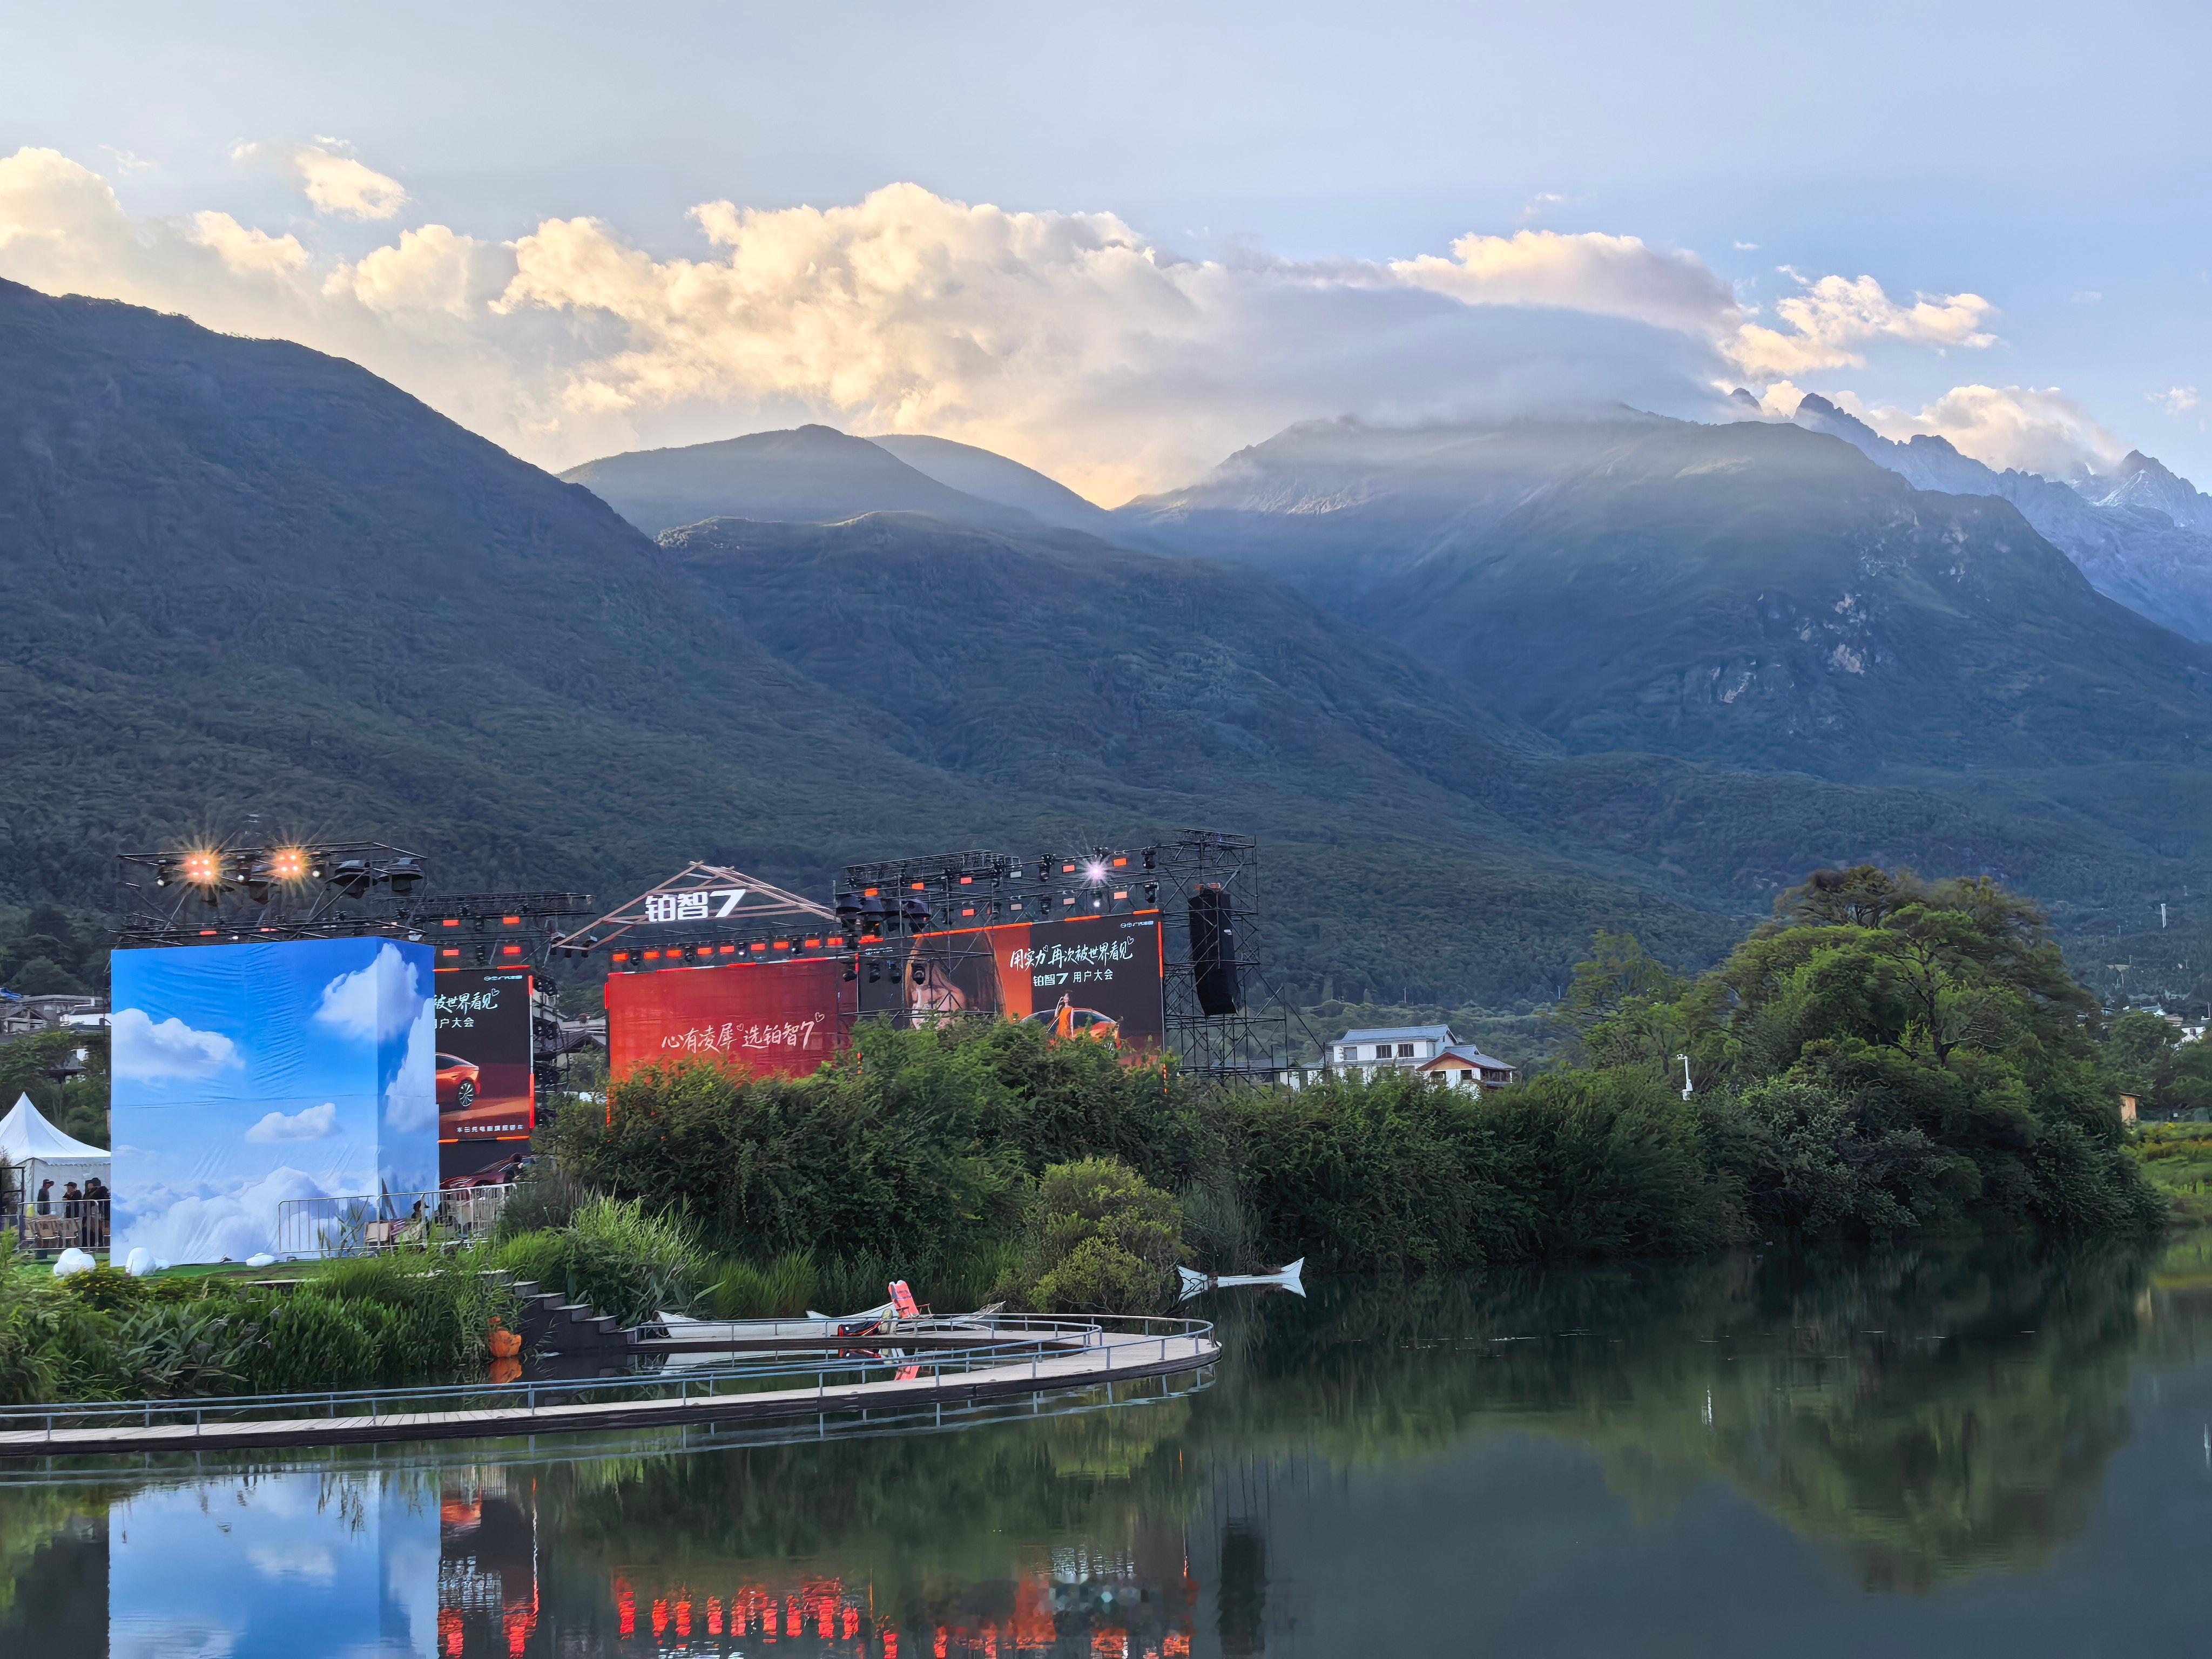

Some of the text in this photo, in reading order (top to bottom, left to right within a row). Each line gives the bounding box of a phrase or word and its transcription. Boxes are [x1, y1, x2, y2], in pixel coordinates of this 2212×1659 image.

[645, 888, 746, 922] 铂智7
[1009, 940, 1134, 972] 用实力 再次被世界看见
[1033, 968, 1113, 987] 铂智7 用户大会
[741, 1021, 815, 1050] 选铂智7
